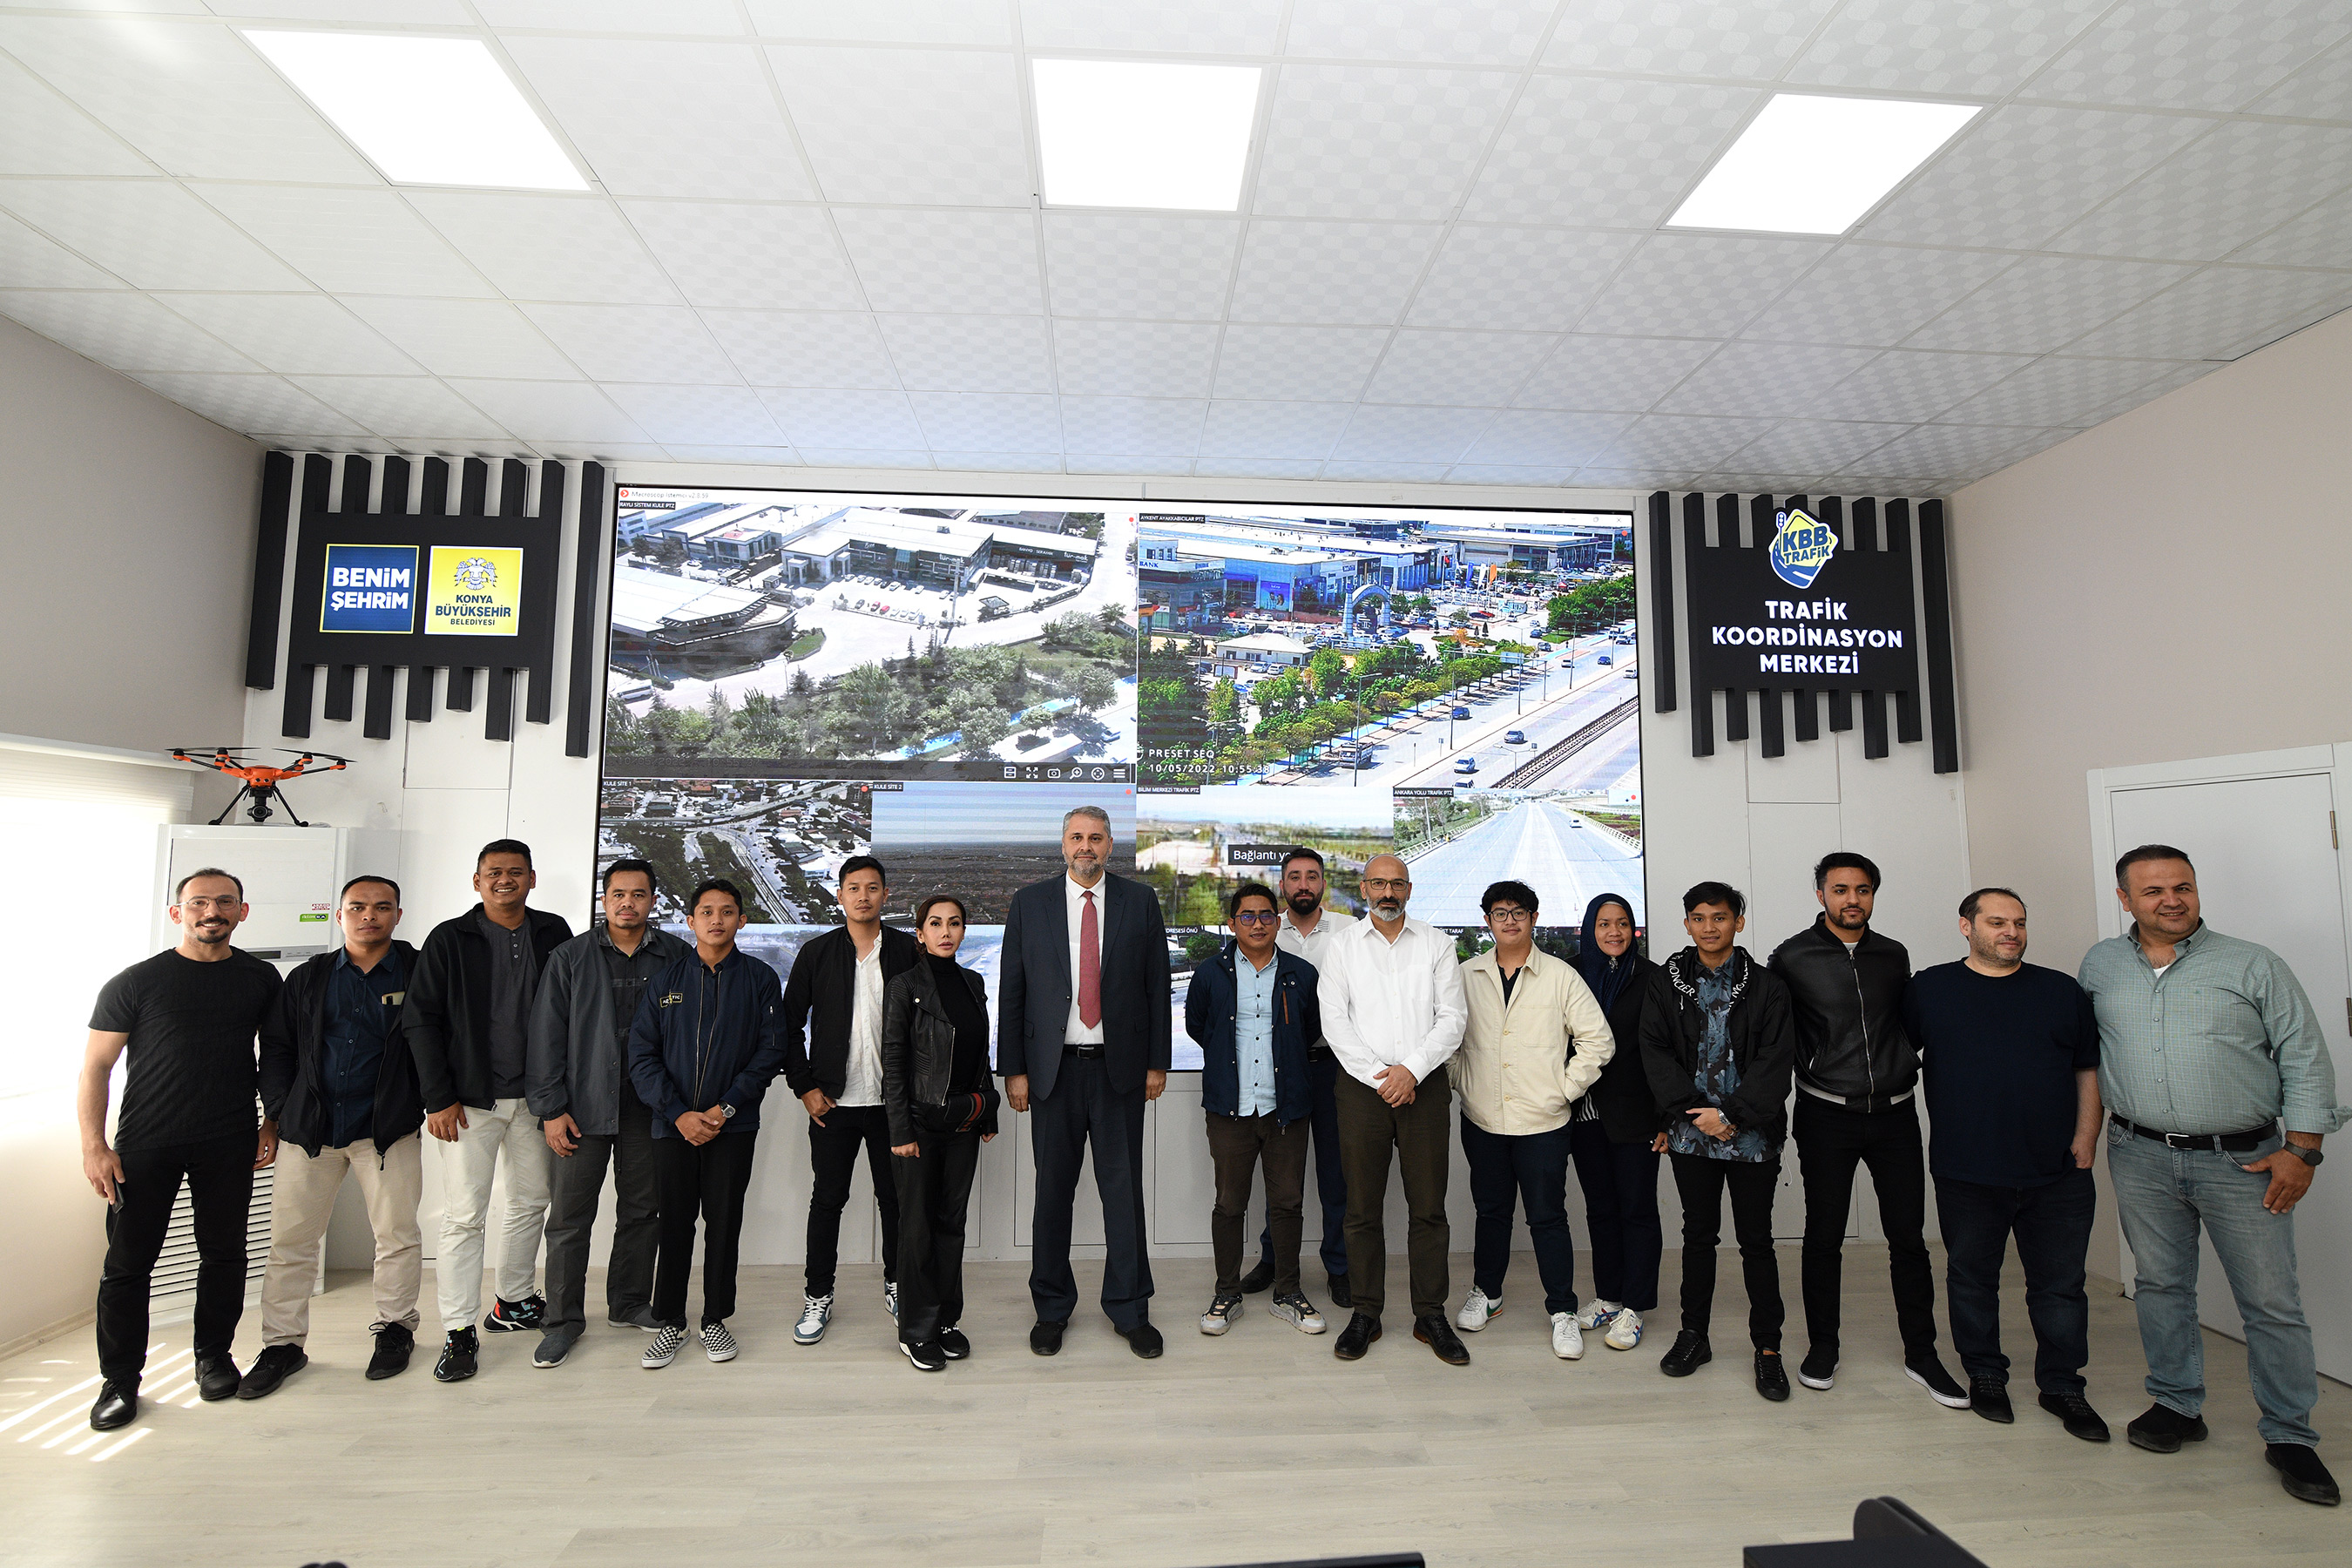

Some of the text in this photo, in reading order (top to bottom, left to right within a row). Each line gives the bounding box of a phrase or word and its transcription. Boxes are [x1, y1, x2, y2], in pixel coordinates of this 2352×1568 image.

[1782, 525, 1828, 552] KBB
[1784, 545, 1830, 564] TRAFİK
[332, 567, 410, 588] BENİM
[330, 591, 409, 612] ŞEHRİM
[456, 594, 493, 604] KONYA
[1764, 597, 1848, 620] TRAFİK
[435, 603, 511, 618] BÜYÜKŞEHİR
[450, 617, 496, 626] BELEDİYESİ
[1712, 623, 1903, 648] KOORDİNASYON
[1760, 651, 1860, 673] MERKEZİ
[1148, 749, 1215, 759] PRESET SEQ
[1149, 764, 1270, 774] 10/05/2022 10:55:38
[1233, 849, 1276, 862] Bağlantı
